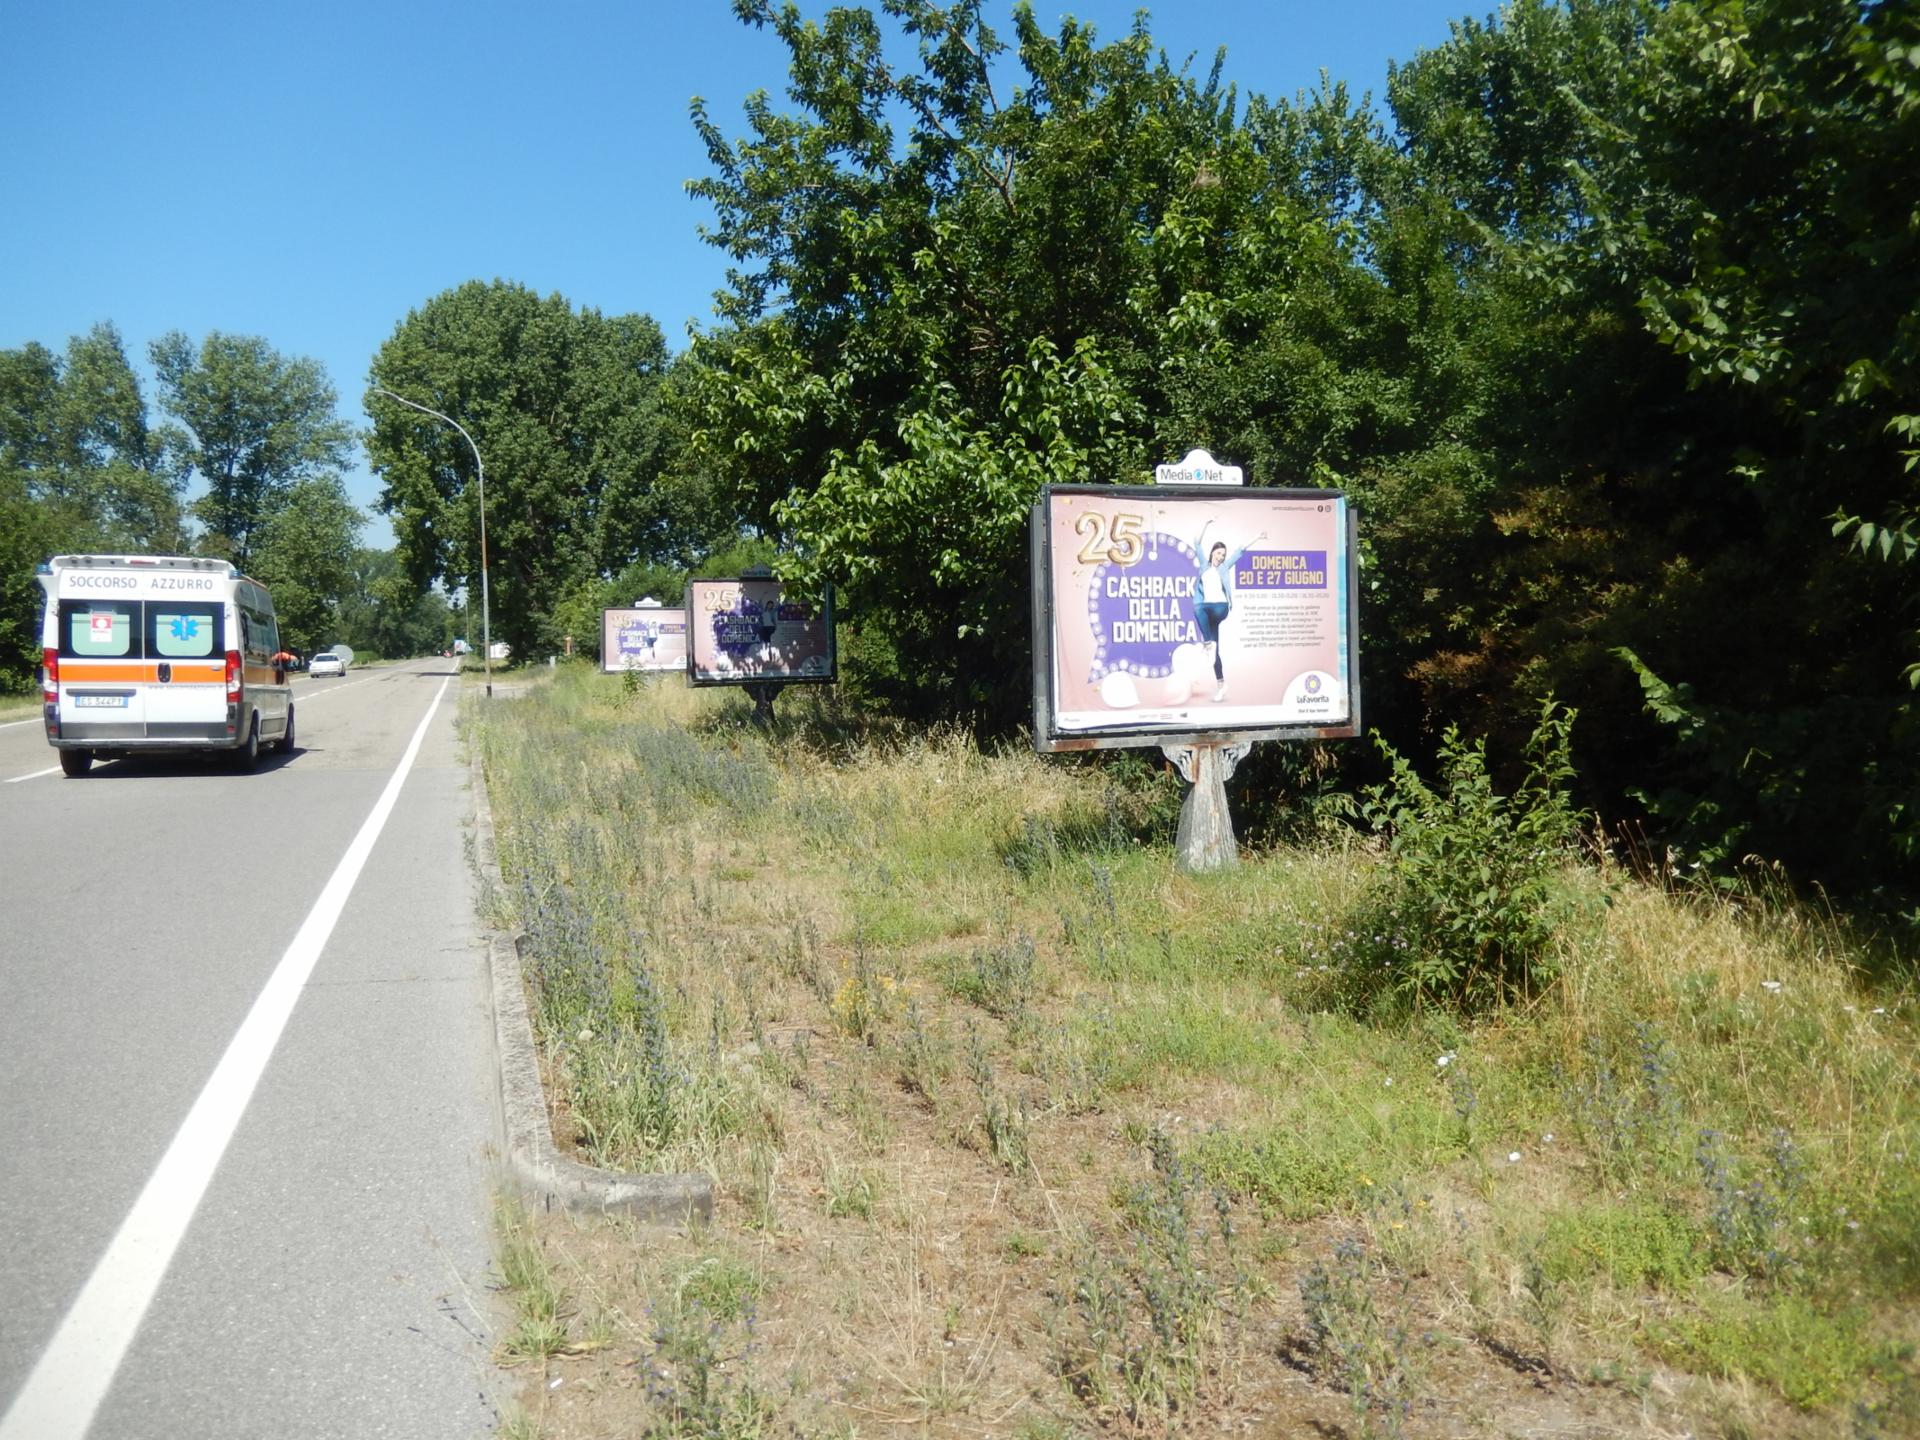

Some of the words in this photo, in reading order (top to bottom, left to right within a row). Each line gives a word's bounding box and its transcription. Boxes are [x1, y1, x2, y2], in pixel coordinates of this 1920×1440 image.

[1160, 468, 1193, 481] Media
[1075, 511, 1144, 566] 25
[1252, 556, 1307, 570] DOMENICA
[69, 576, 137, 588] SOCCORSO
[151, 578, 213, 590] AZZURRO
[1106, 576, 1197, 598] CASHBACK
[1239, 571, 1254, 585] 20
[1257, 571, 1264, 585] E
[1267, 571, 1281, 585] 27
[1284, 571, 1324, 585] GIUGNO
[704, 590, 736, 612] 25
[1129, 599, 1181, 620] DELLA
[1113, 621, 1198, 643] DOMENICA
